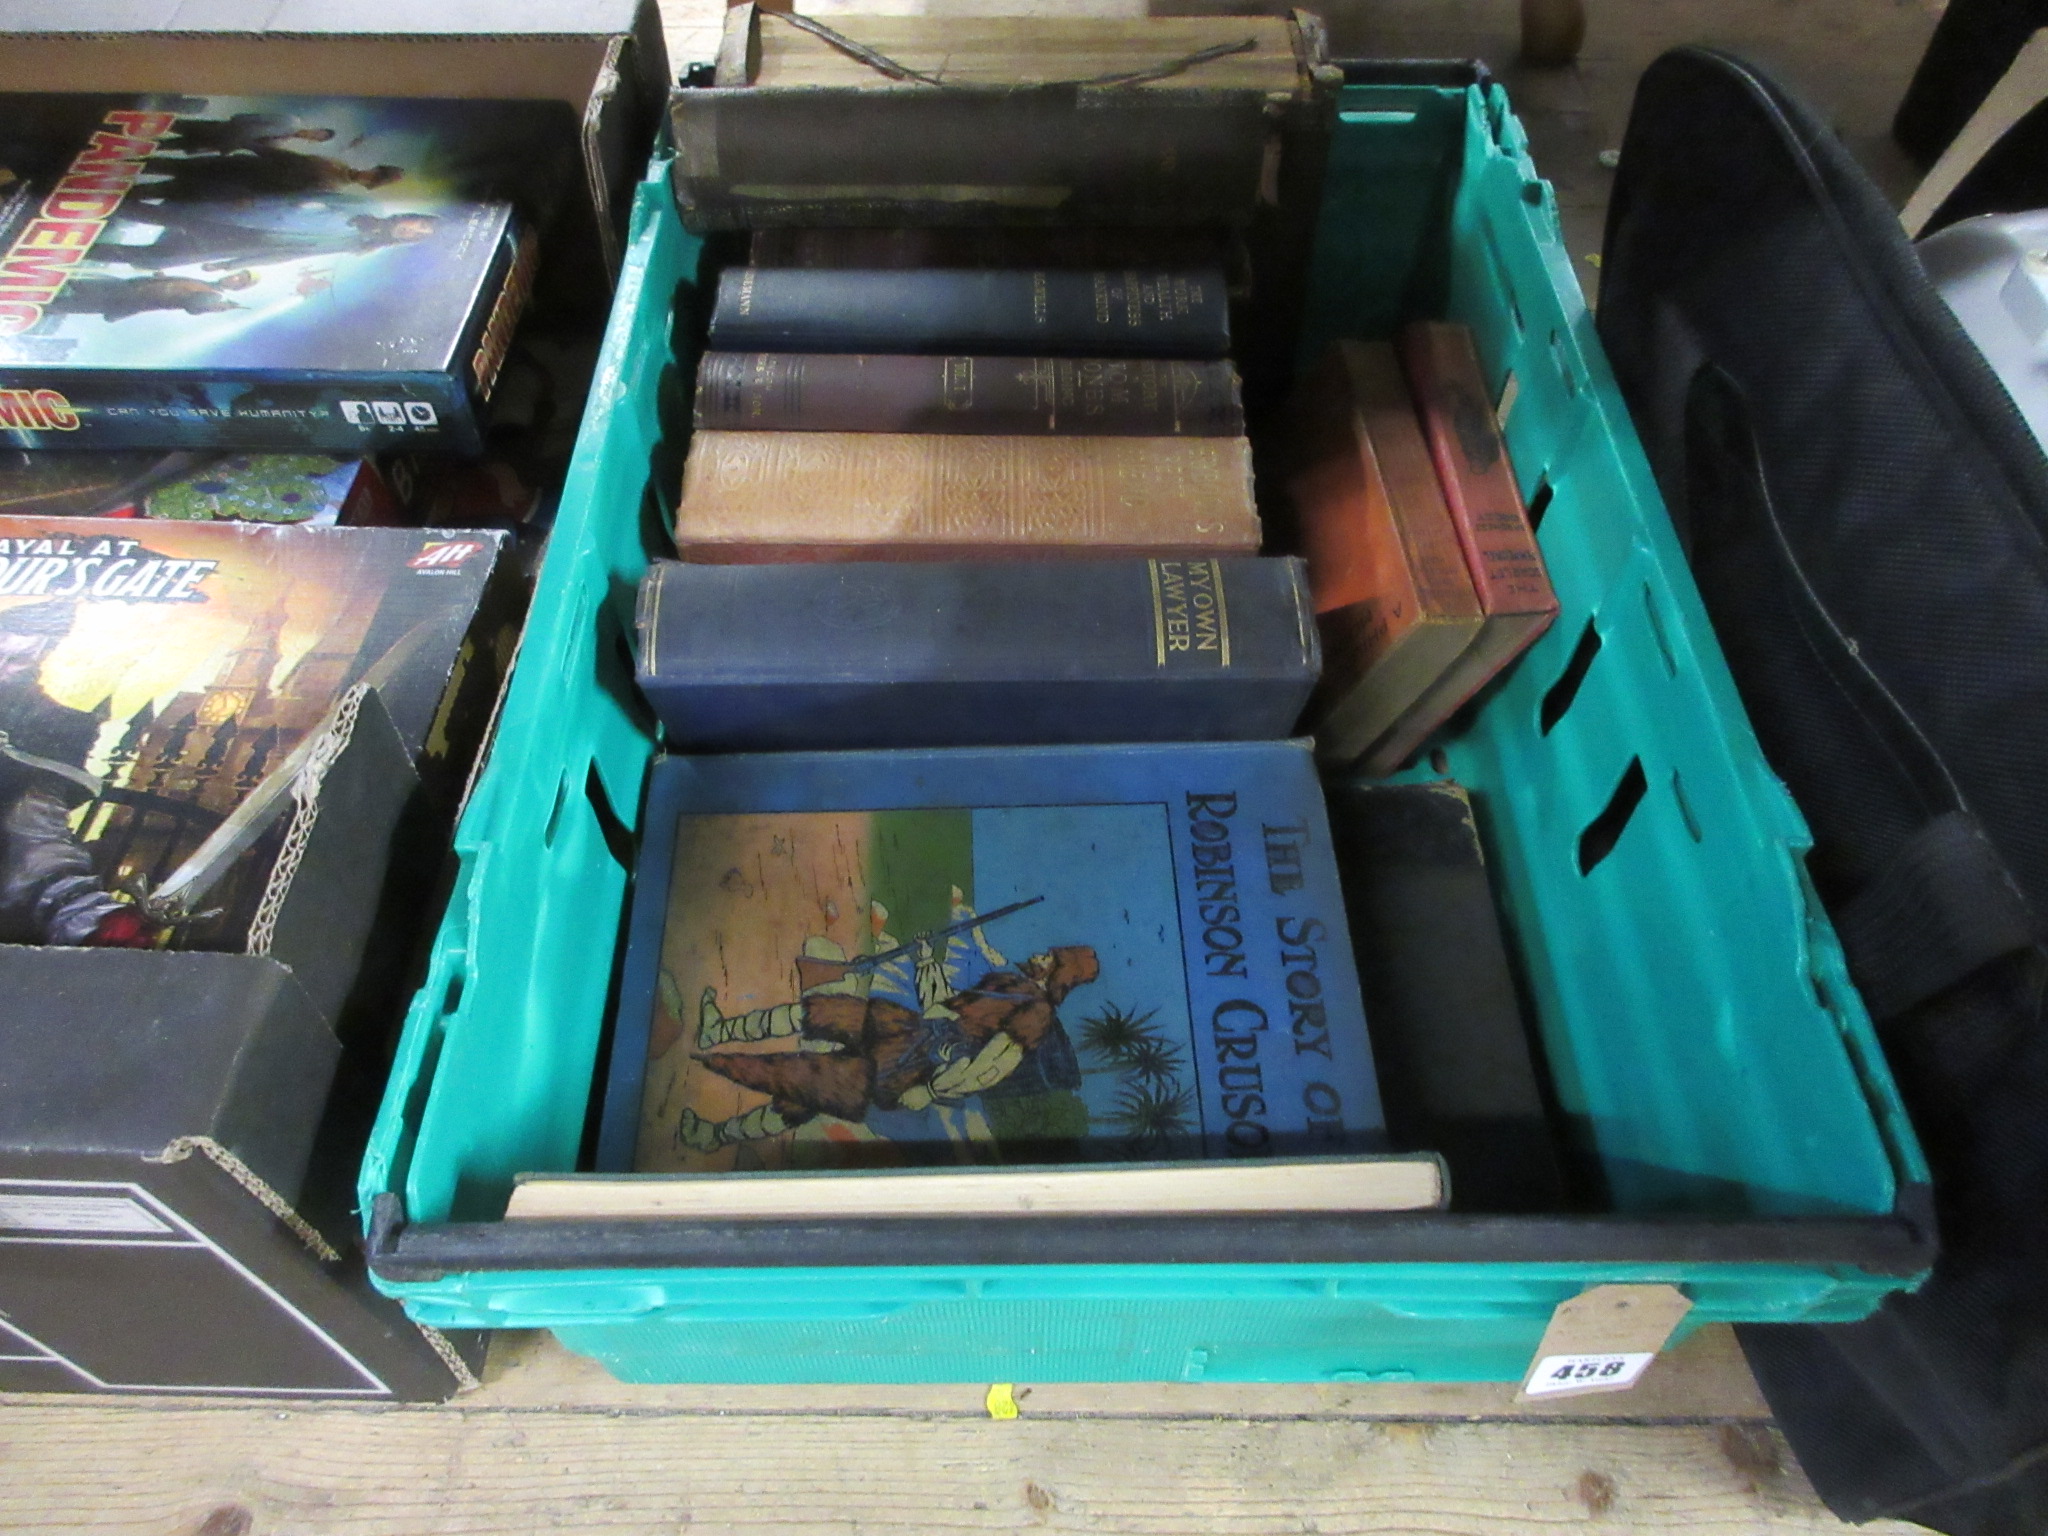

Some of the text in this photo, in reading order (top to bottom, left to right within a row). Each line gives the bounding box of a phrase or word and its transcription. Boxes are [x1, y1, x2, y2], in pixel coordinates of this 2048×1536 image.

[106, 406, 140, 416] CAN
[148, 406, 181, 417] YOU
[187, 407, 231, 417] SAVE
[90, 540, 140, 556] AT
[92, 559, 218, 598] GATE
[1160, 562, 1190, 652] LAWYER
[1186, 561, 1218, 651] MY OWN
[1185, 790, 1247, 979] ROBINSON
[1262, 822, 1310, 896] THE
[1275, 916, 1332, 1061] STORY
[1550, 1361, 1625, 1380] 458
